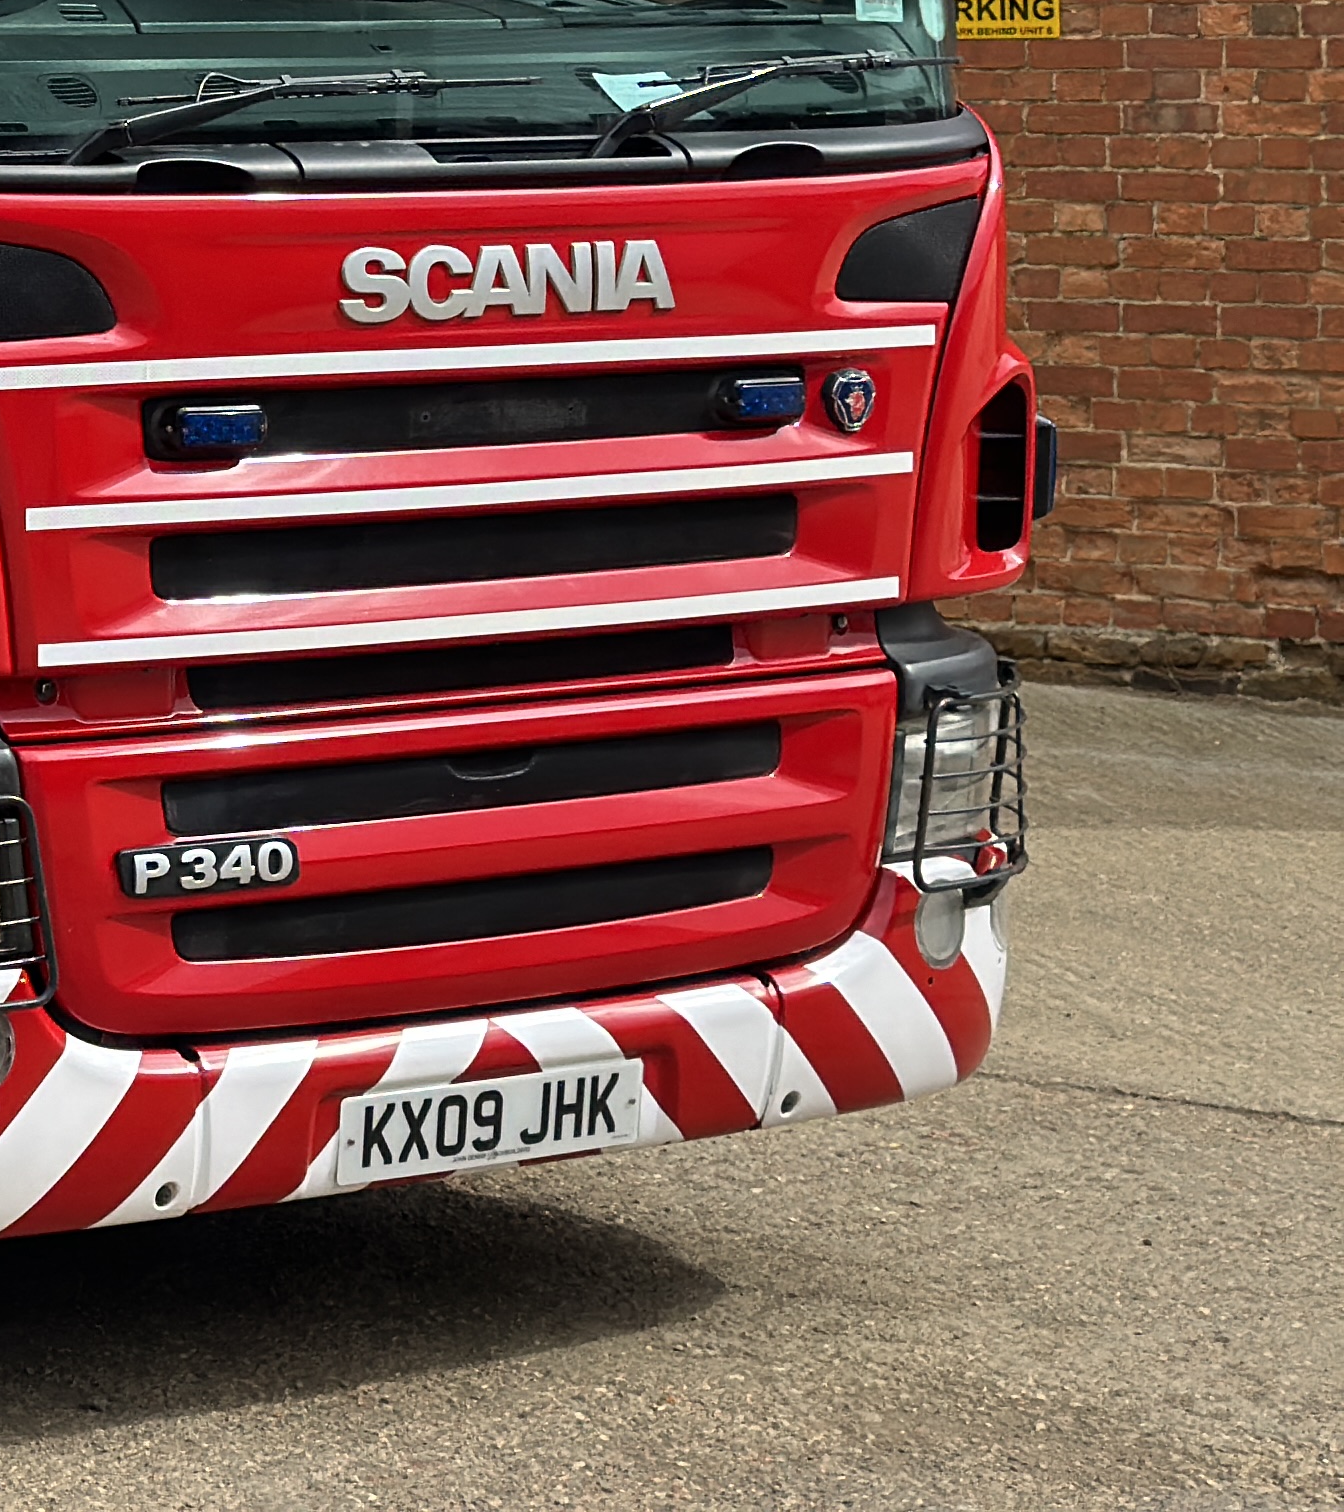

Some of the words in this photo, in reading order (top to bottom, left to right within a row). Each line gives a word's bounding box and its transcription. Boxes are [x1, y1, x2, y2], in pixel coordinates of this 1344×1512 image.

[339, 239, 676, 324] SCANIA
[179, 841, 294, 890] 340
[362, 1090, 504, 1168] KX09
[519, 1072, 620, 1146] JHK
